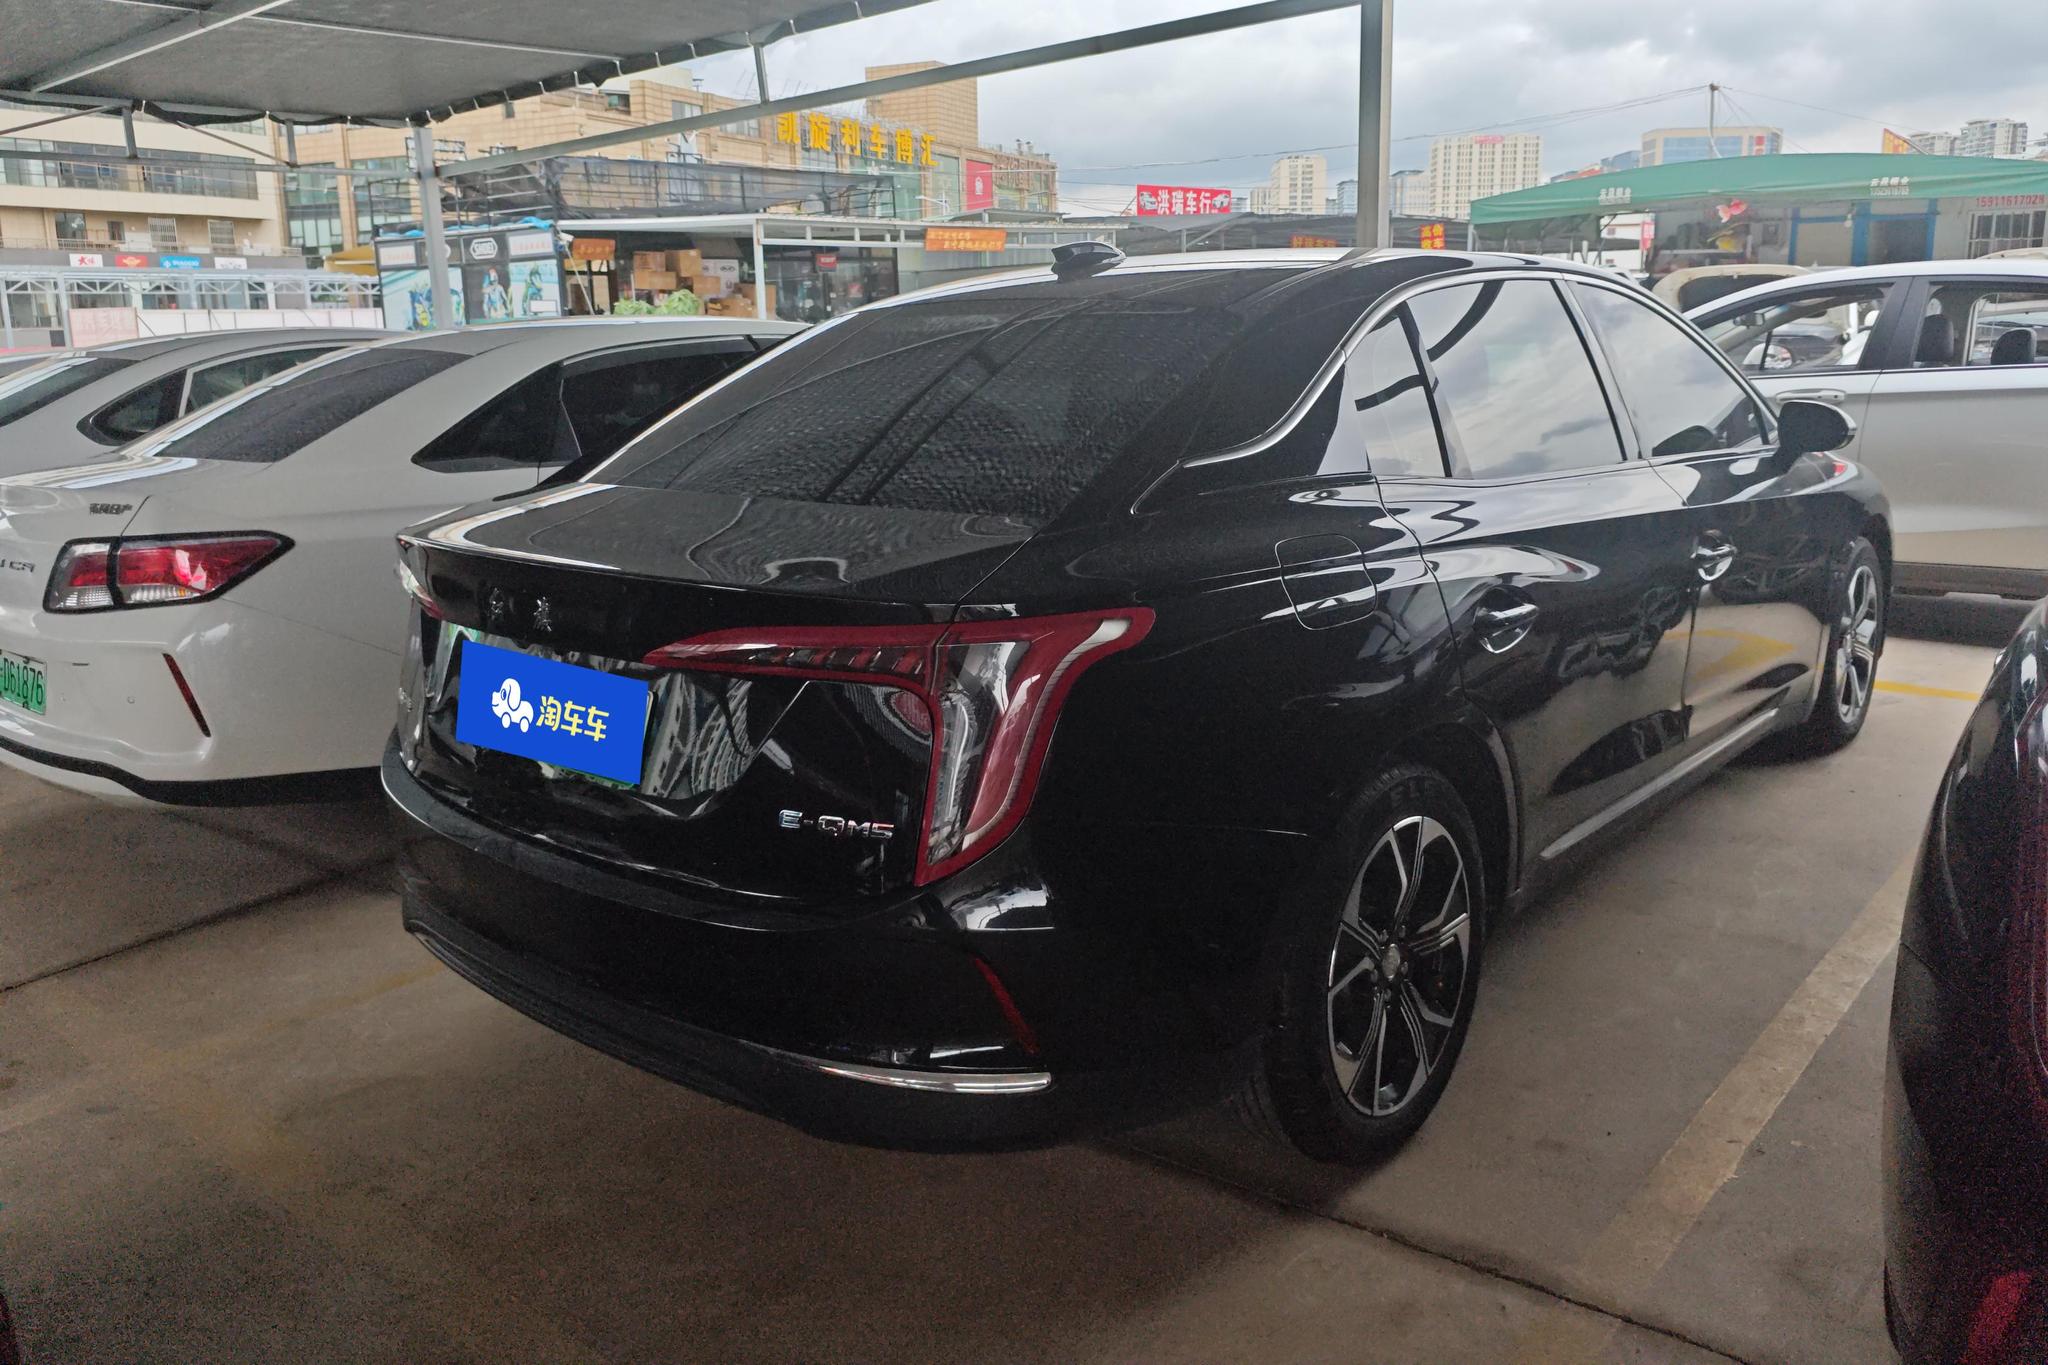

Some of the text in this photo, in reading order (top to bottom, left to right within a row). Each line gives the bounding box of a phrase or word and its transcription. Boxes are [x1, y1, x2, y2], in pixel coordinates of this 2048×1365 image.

[1157, 188, 1212, 215] 洪瑞车行
[779, 809, 895, 839] E-QM5
